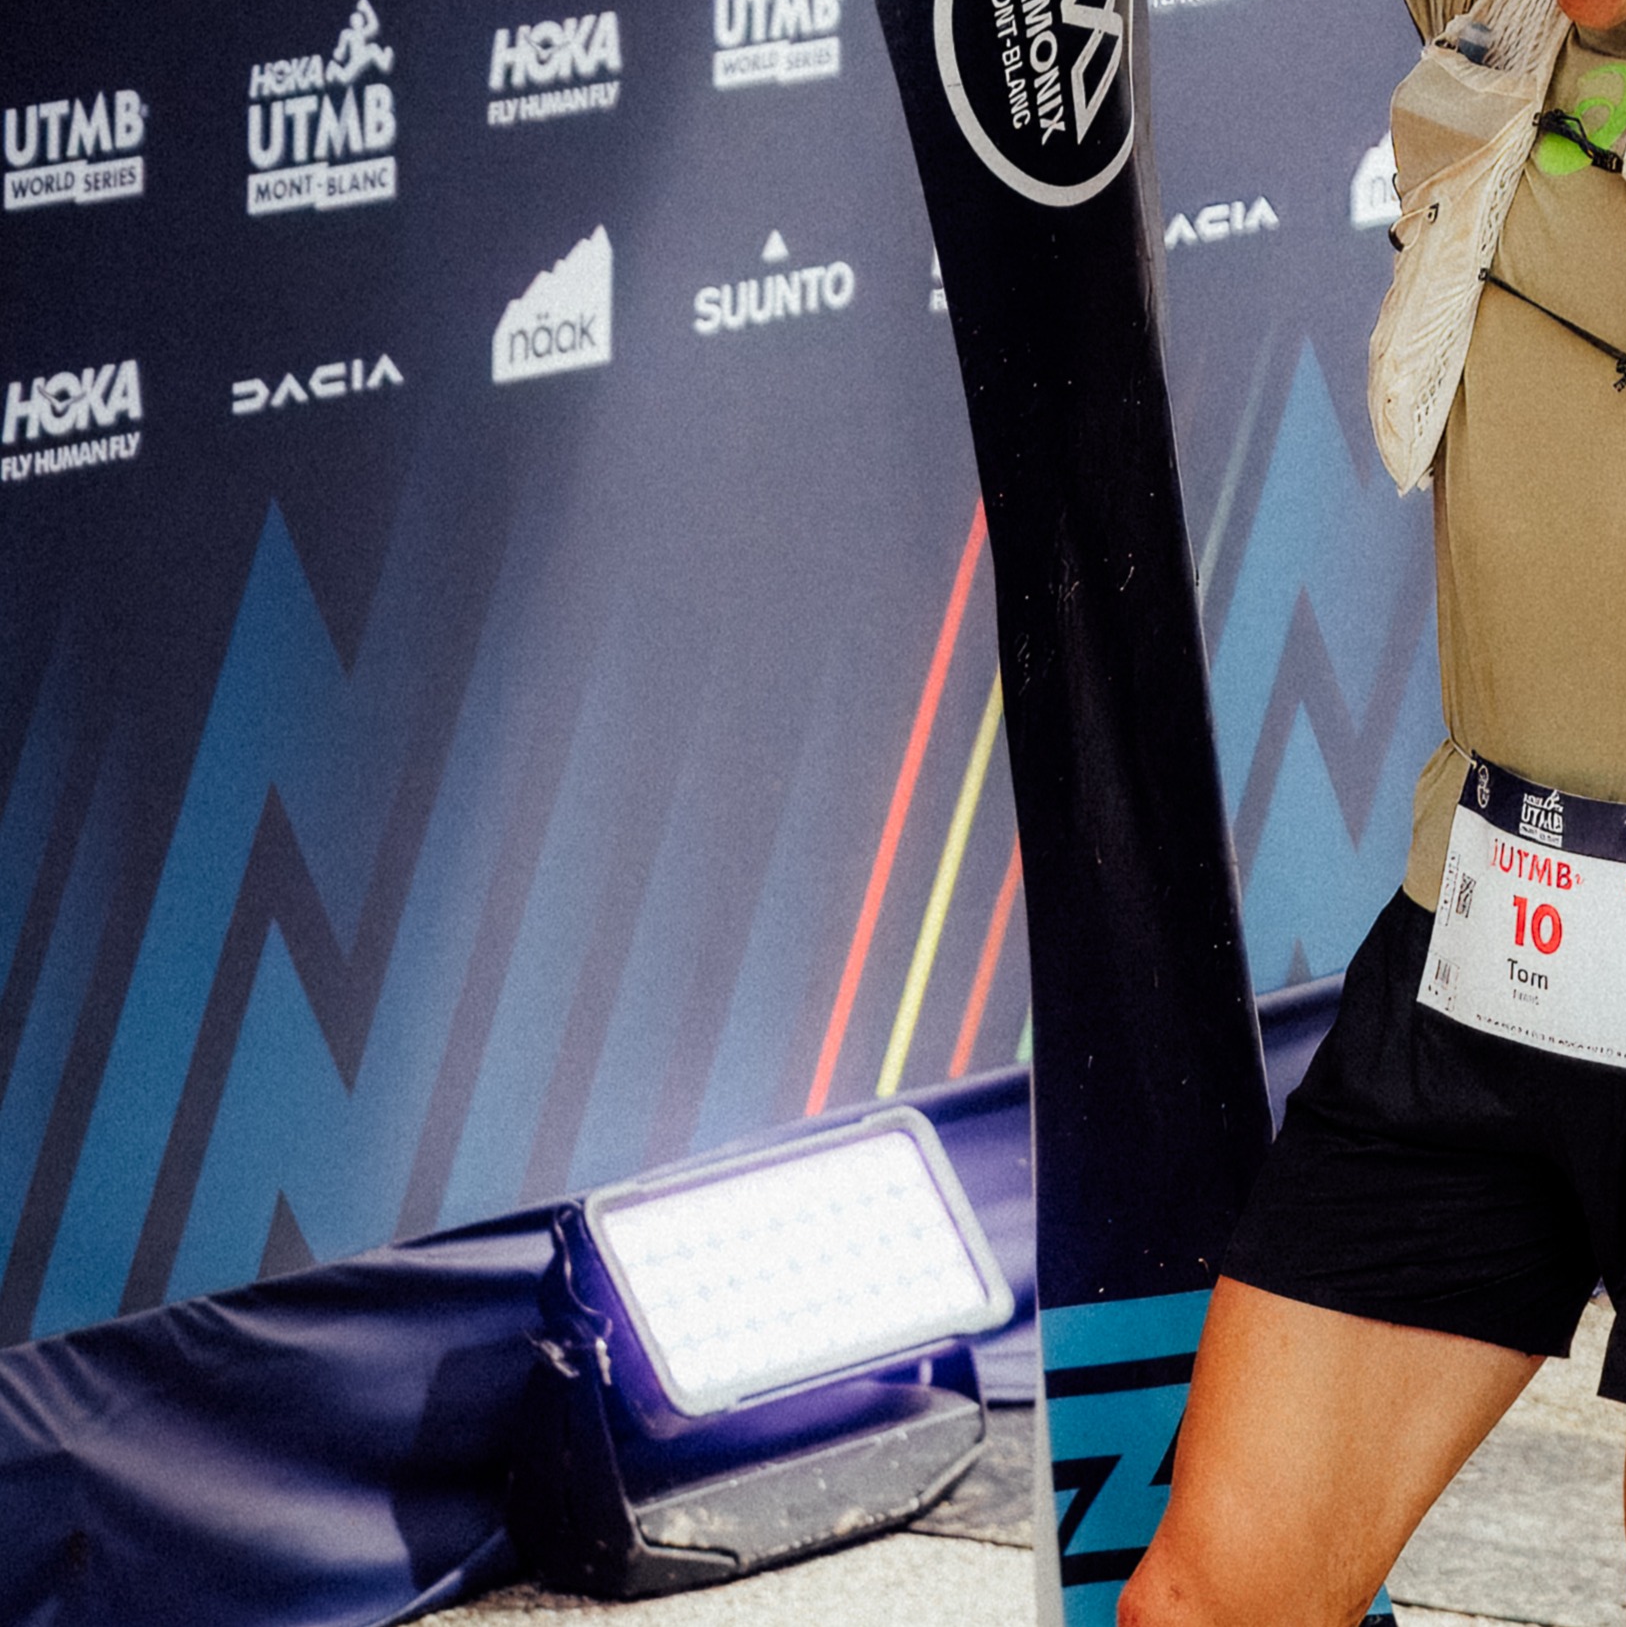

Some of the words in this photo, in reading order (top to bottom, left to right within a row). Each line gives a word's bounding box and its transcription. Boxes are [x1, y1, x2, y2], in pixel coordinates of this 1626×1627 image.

[249, 54, 325, 99] HOKA
[489, 10, 621, 91] HOKA
[4, 89, 145, 167] UTMB
[247, 83, 397, 169] UTMB
[488, 98, 519, 126] FLY
[519, 88, 590, 121] HUMAN
[589, 80, 620, 110] FLY
[11, 171, 75, 199] WORLD
[84, 165, 137, 193] SERIES
[255, 167, 389, 203] MONT-BLANC
[1163, 194, 1280, 250] ACIA
[694, 260, 856, 333] SUUNTO
[509, 312, 596, 365] näak
[1, 359, 143, 444] HOKA
[232, 354, 404, 415] DACIA
[1, 454, 32, 483] FLY
[34, 438, 111, 474] HUMAN
[110, 431, 140, 460] FLY
[1512, 894, 1563, 955] 10
[1507, 957, 1549, 990] Tom
